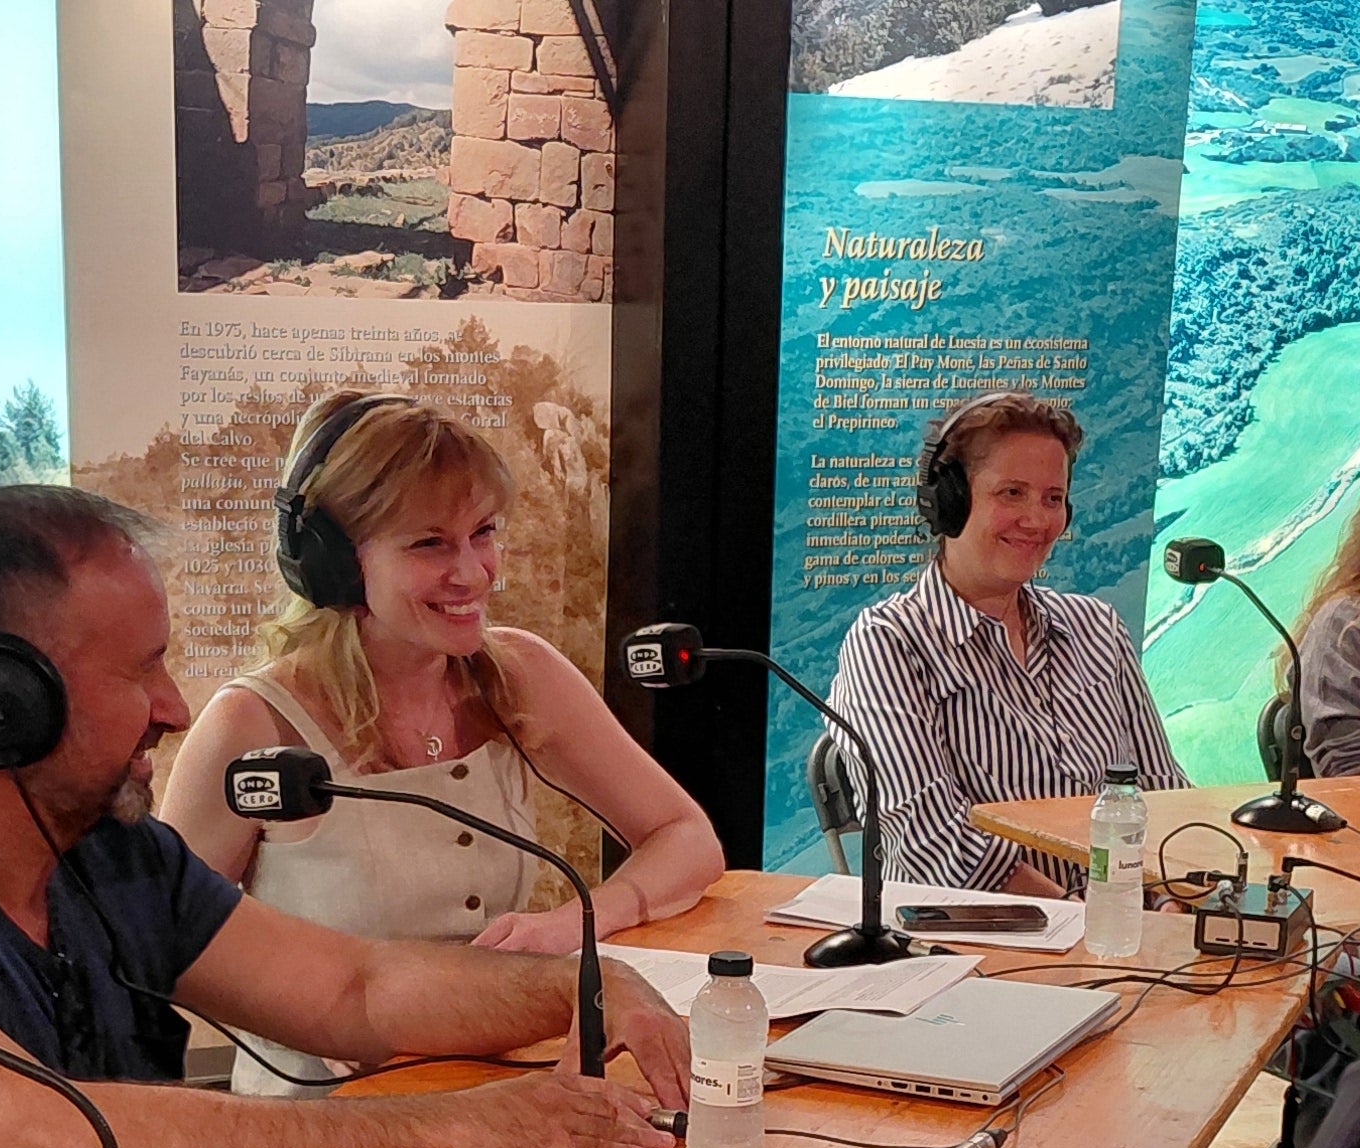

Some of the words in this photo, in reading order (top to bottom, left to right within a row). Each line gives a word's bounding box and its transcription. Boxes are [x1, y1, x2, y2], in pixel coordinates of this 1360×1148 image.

[822, 226, 985, 262] Naturaleza
[819, 276, 838, 309] y
[840, 268, 943, 310] paisaje
[179, 321, 201, 336] En
[205, 321, 247, 340] 1975,
[251, 322, 288, 338] hace
[291, 328, 345, 343] apenas
[351, 326, 399, 341] treinta
[832, 336, 882, 349] entorno
[885, 333, 928, 349] natural
[949, 335, 987, 350] Luesia
[1024, 335, 1088, 351] ecosistema
[180, 343, 257, 360] descubrió
[262, 348, 301, 361] cerca
[330, 346, 392, 363] Sibirana
[445, 350, 500, 364] montes
[911, 355, 934, 374] Puy
[979, 354, 995, 370] las
[999, 355, 1034, 370] Peñas
[1054, 355, 1088, 370] Santo
[180, 365, 248, 385] Fayanás,
[280, 367, 347, 384] conjunto
[352, 367, 419, 384] medieval
[424, 369, 487, 385] formado
[815, 373, 879, 392] Domingo,
[896, 375, 930, 390] sierra
[951, 374, 1009, 390] Lucientes
[1021, 374, 1038, 389] los
[1041, 375, 1086, 389] Montes
[212, 387, 233, 404] los
[447, 392, 513, 408] estancias
[833, 393, 859, 409] Biel
[862, 394, 909, 410] forman
[230, 410, 302, 429] necrópoli
[180, 431, 204, 446] del
[210, 432, 253, 446] Calvo
[205, 456, 237, 468] cree
[242, 456, 273, 472] que
[829, 453, 896, 469] naturaleza
[809, 473, 850, 490] claros,
[808, 494, 881, 512] contemplar
[181, 519, 258, 532] estableció
[807, 512, 867, 527] cordillera
[205, 540, 254, 555] iglesia
[806, 531, 871, 547] inmediato
[184, 560, 219, 574] 1025
[804, 554, 840, 570] gama
[862, 550, 906, 566] colores
[815, 572, 850, 589] pinos
[882, 569, 900, 583] los
[240, 780, 272, 790] ONDA
[243, 795, 273, 804] CERO
